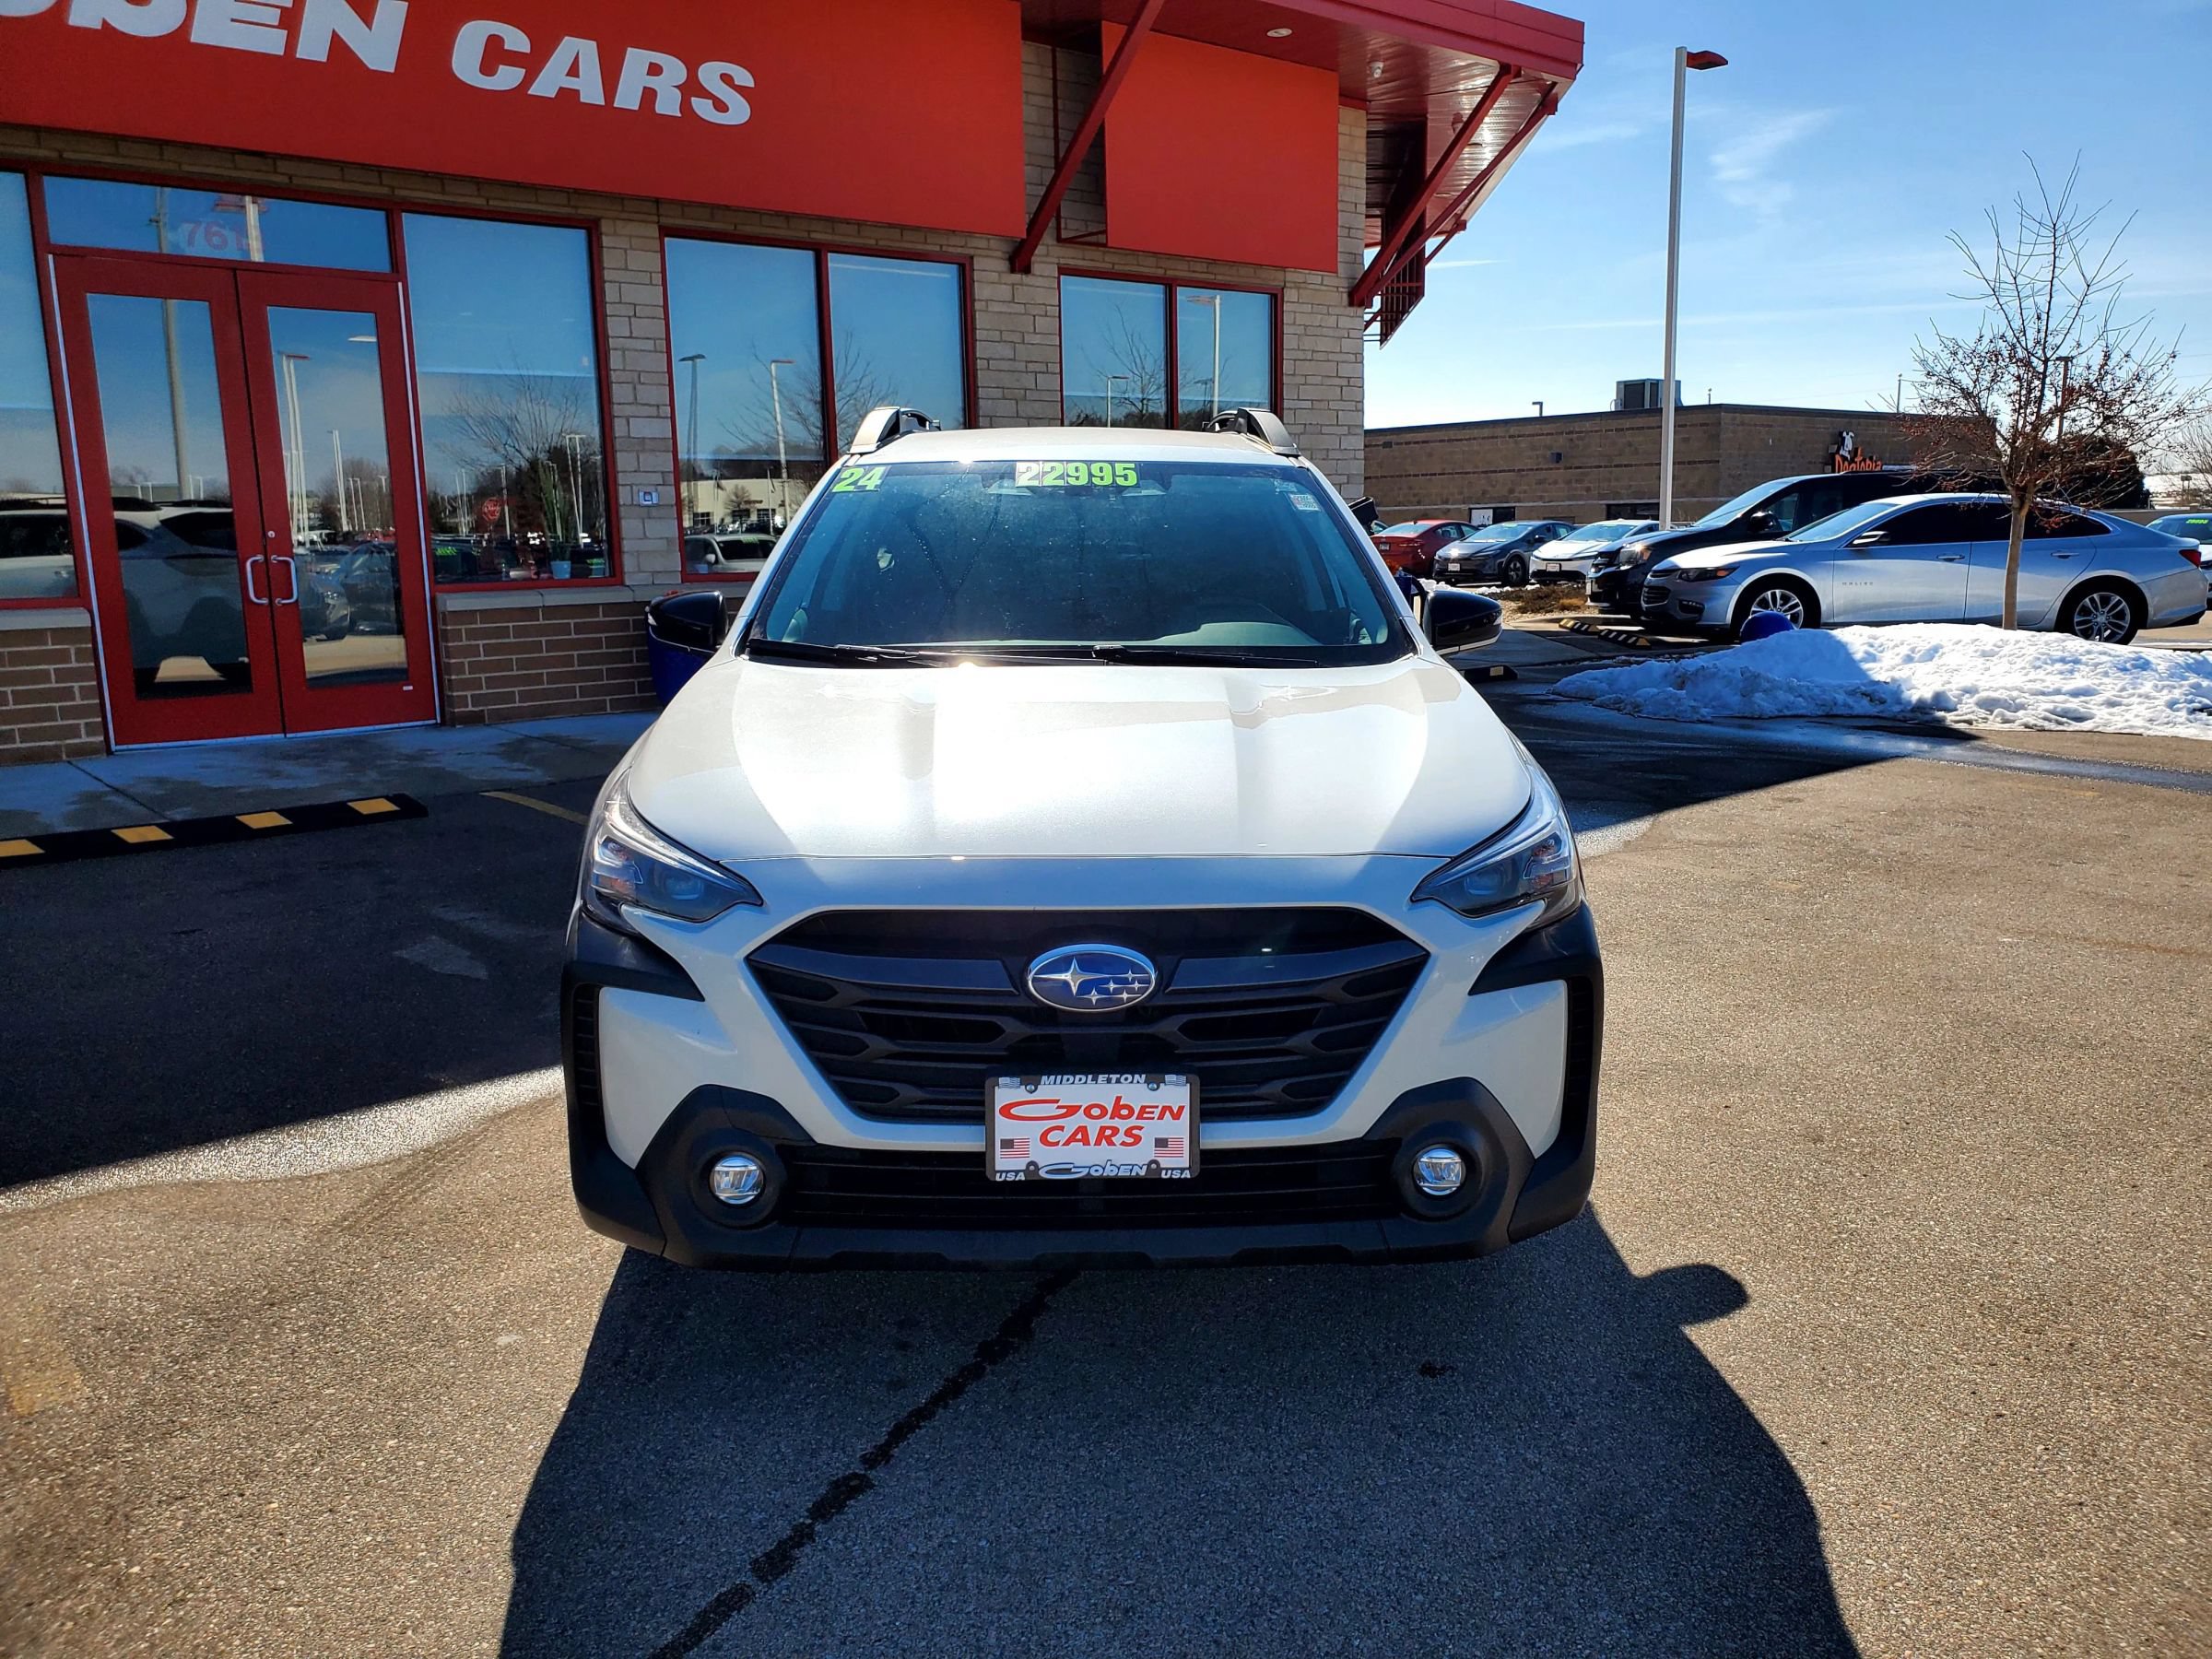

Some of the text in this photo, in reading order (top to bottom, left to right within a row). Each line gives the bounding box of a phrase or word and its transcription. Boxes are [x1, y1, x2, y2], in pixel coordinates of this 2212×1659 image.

[452, 19, 755, 125] CARS
[832, 466, 886, 492] 24
[1016, 462, 1137, 487] 22995
[1041, 1074, 1146, 1085] MIDDLETON
[1039, 1124, 1145, 1147] CARS
[995, 1171, 1026, 1182] USA
[1160, 1170, 1191, 1179] USA
